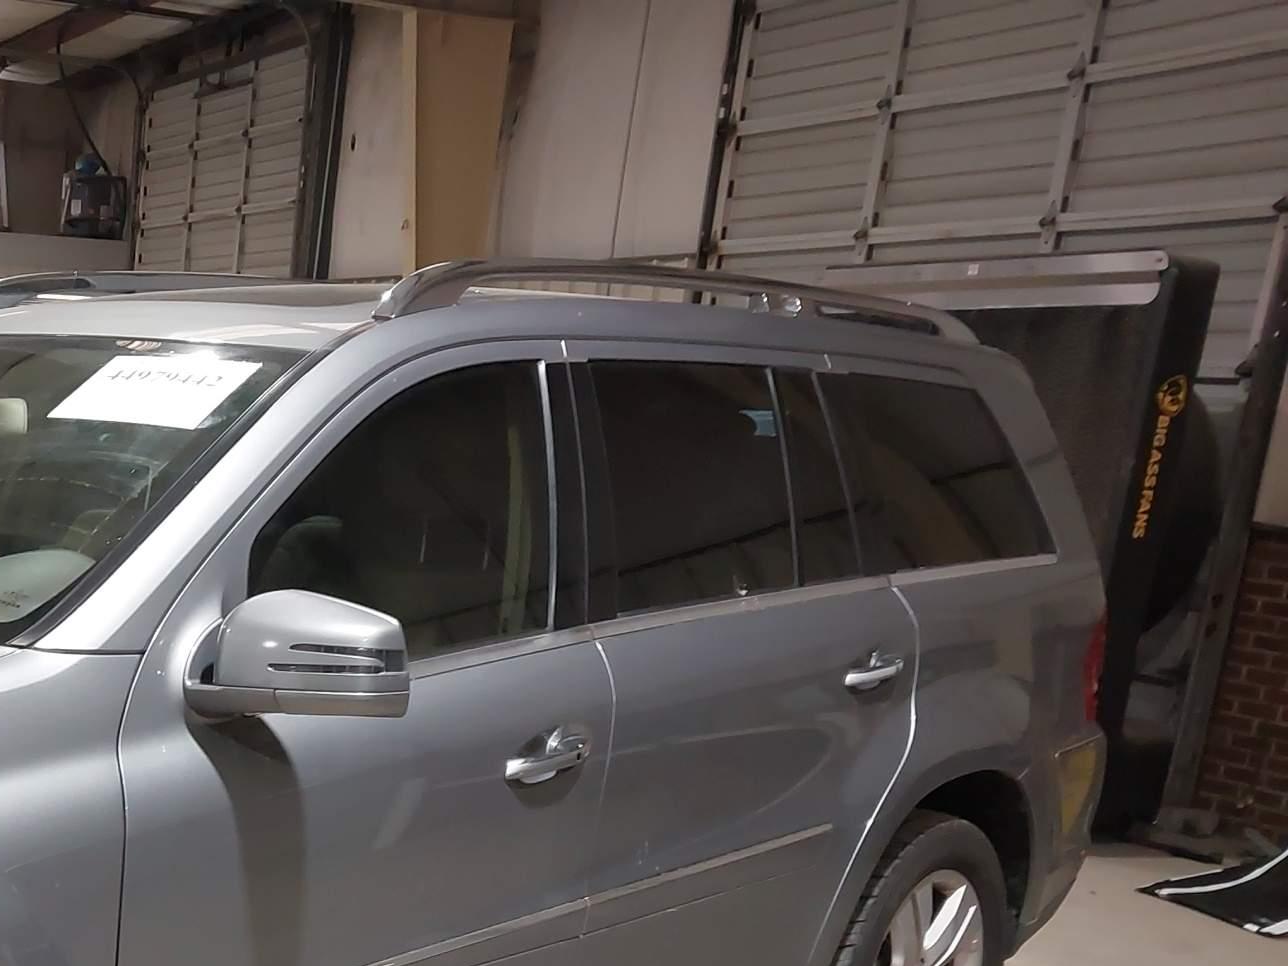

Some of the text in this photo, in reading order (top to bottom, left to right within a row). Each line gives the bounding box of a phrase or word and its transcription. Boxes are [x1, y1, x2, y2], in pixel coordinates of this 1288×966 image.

[1131, 415, 1171, 539] BIG ASS FANS
